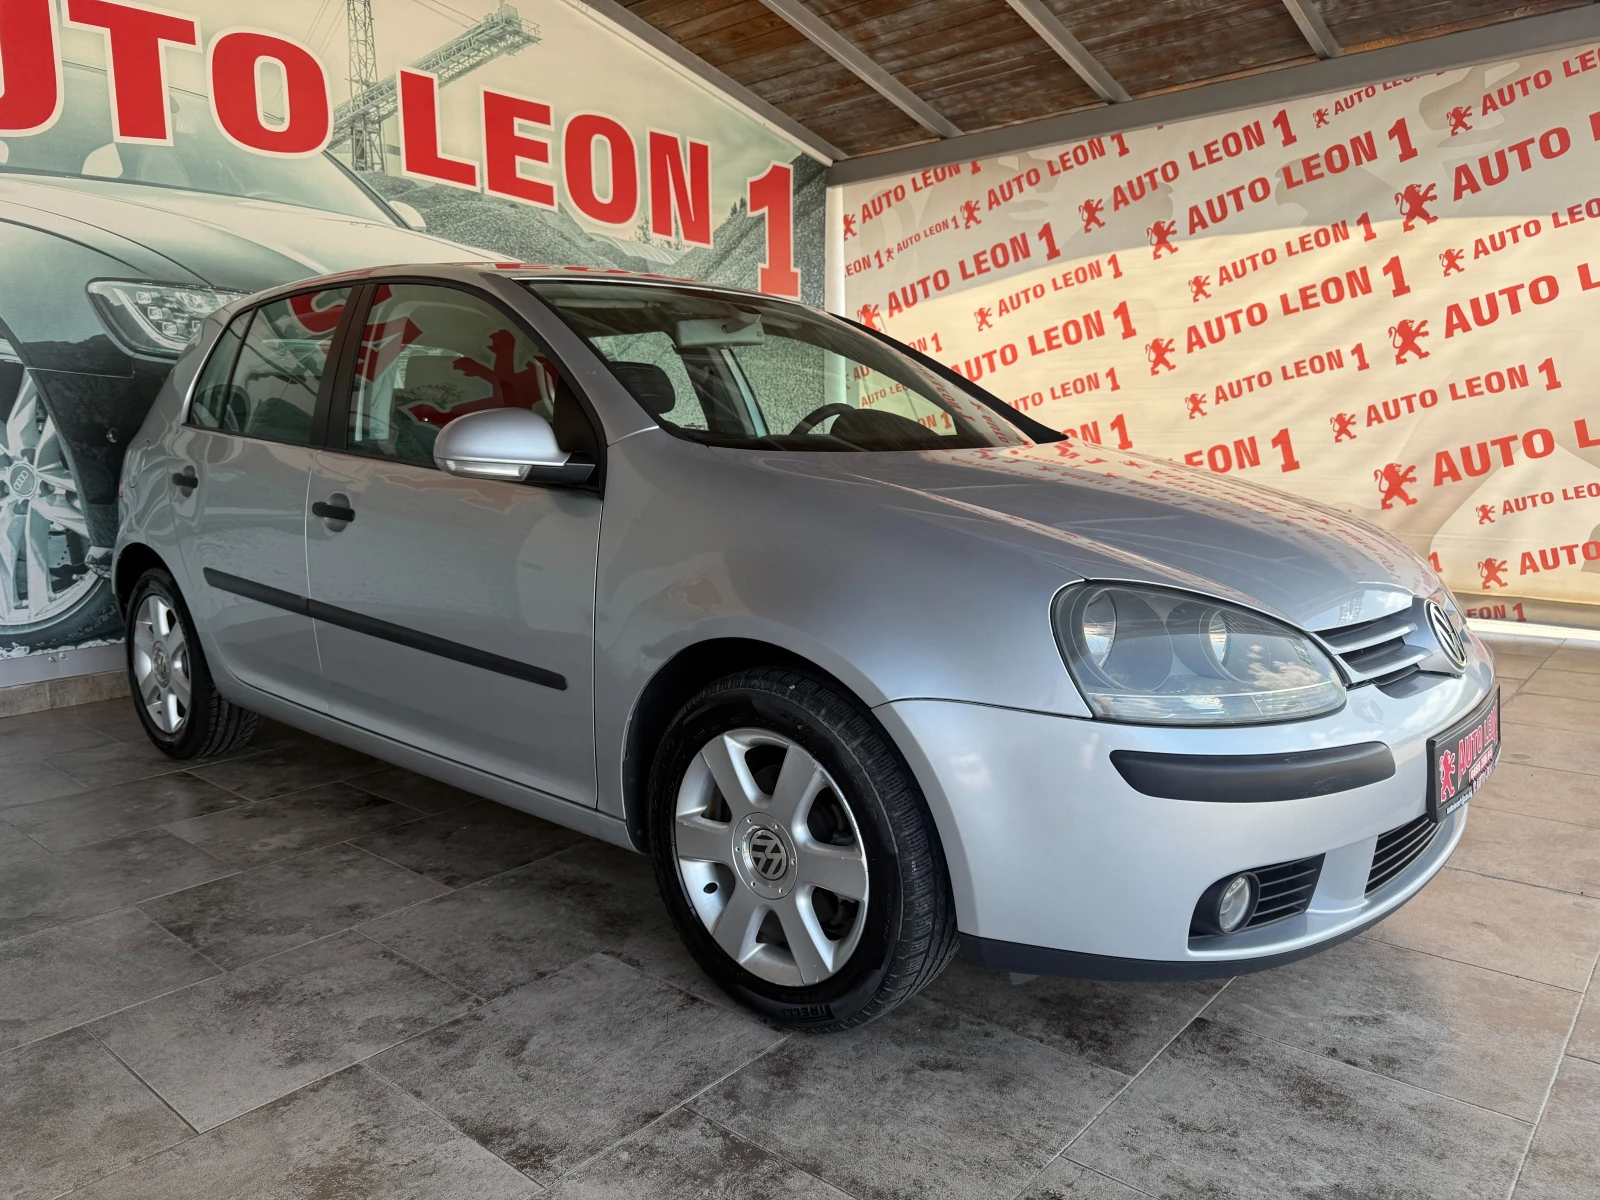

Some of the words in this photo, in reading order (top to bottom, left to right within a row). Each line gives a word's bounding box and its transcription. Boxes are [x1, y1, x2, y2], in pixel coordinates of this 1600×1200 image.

[1334, 84, 1376, 115] AUTO
[1481, 68, 1553, 117] AUTO
[1562, 46, 1600, 78] LE
[399, 69, 712, 246] LEON
[748, 164, 800, 298] 1
[987, 165, 1040, 211] AUTO
[1046, 137, 1106, 177] LEON
[1110, 133, 1130, 158] 1
[1113, 160, 1180, 212] AUTO
[1188, 120, 1266, 171] LEON
[1271, 109, 1298, 147] 1
[1188, 176, 1271, 236] AUTO
[1281, 130, 1378, 190] LEON
[1387, 117, 1419, 163] 1
[1452, 126, 1572, 201] AUTO
[861, 184, 906, 224] AUTO
[844, 254, 872, 278] EON
[874, 250, 885, 269] 1
[896, 232, 922, 254] AUTO
[923, 218, 950, 238] LEON
[951, 215, 960, 230] 1
[1218, 247, 1278, 287] AUTO
[1284, 219, 1351, 258] LEON
[1356, 212, 1378, 243] 1
[1473, 218, 1542, 261] AUTO
[887, 269, 951, 319] AUTO
[958, 232, 1032, 281] LEON
[1037, 222, 1062, 261] 1
[998, 283, 1046, 318] AUTO
[1051, 259, 1103, 292] LEON
[1106, 253, 1124, 280] 1
[1027, 309, 1106, 357] LEON
[1111, 300, 1138, 341] 1
[1186, 301, 1269, 355] AUTO
[1279, 265, 1374, 317] LEON
[1381, 255, 1412, 298] 1
[1444, 274, 1560, 340] AUTO
[930, 332, 943, 353] 1
[860, 387, 887, 408] AUTO
[1049, 371, 1101, 402] LEON
[1104, 367, 1121, 393] 1
[1214, 370, 1273, 406] AUTO
[1280, 348, 1345, 382] LEON
[1350, 342, 1371, 372] 1
[1365, 388, 1439, 428] AUTO
[1448, 363, 1530, 402] LEON
[1537, 357, 1563, 391] 1
[1109, 413, 1134, 452] 1
[1270, 427, 1301, 473] 1
[1432, 427, 1556, 488] AUTO
[1502, 491, 1555, 516] AUTO
[1427, 551, 1443, 574] 1
[1519, 540, 1600, 576] AUTO
[1512, 602, 1527, 623] 1
[1458, 725, 1483, 790] AUTO
